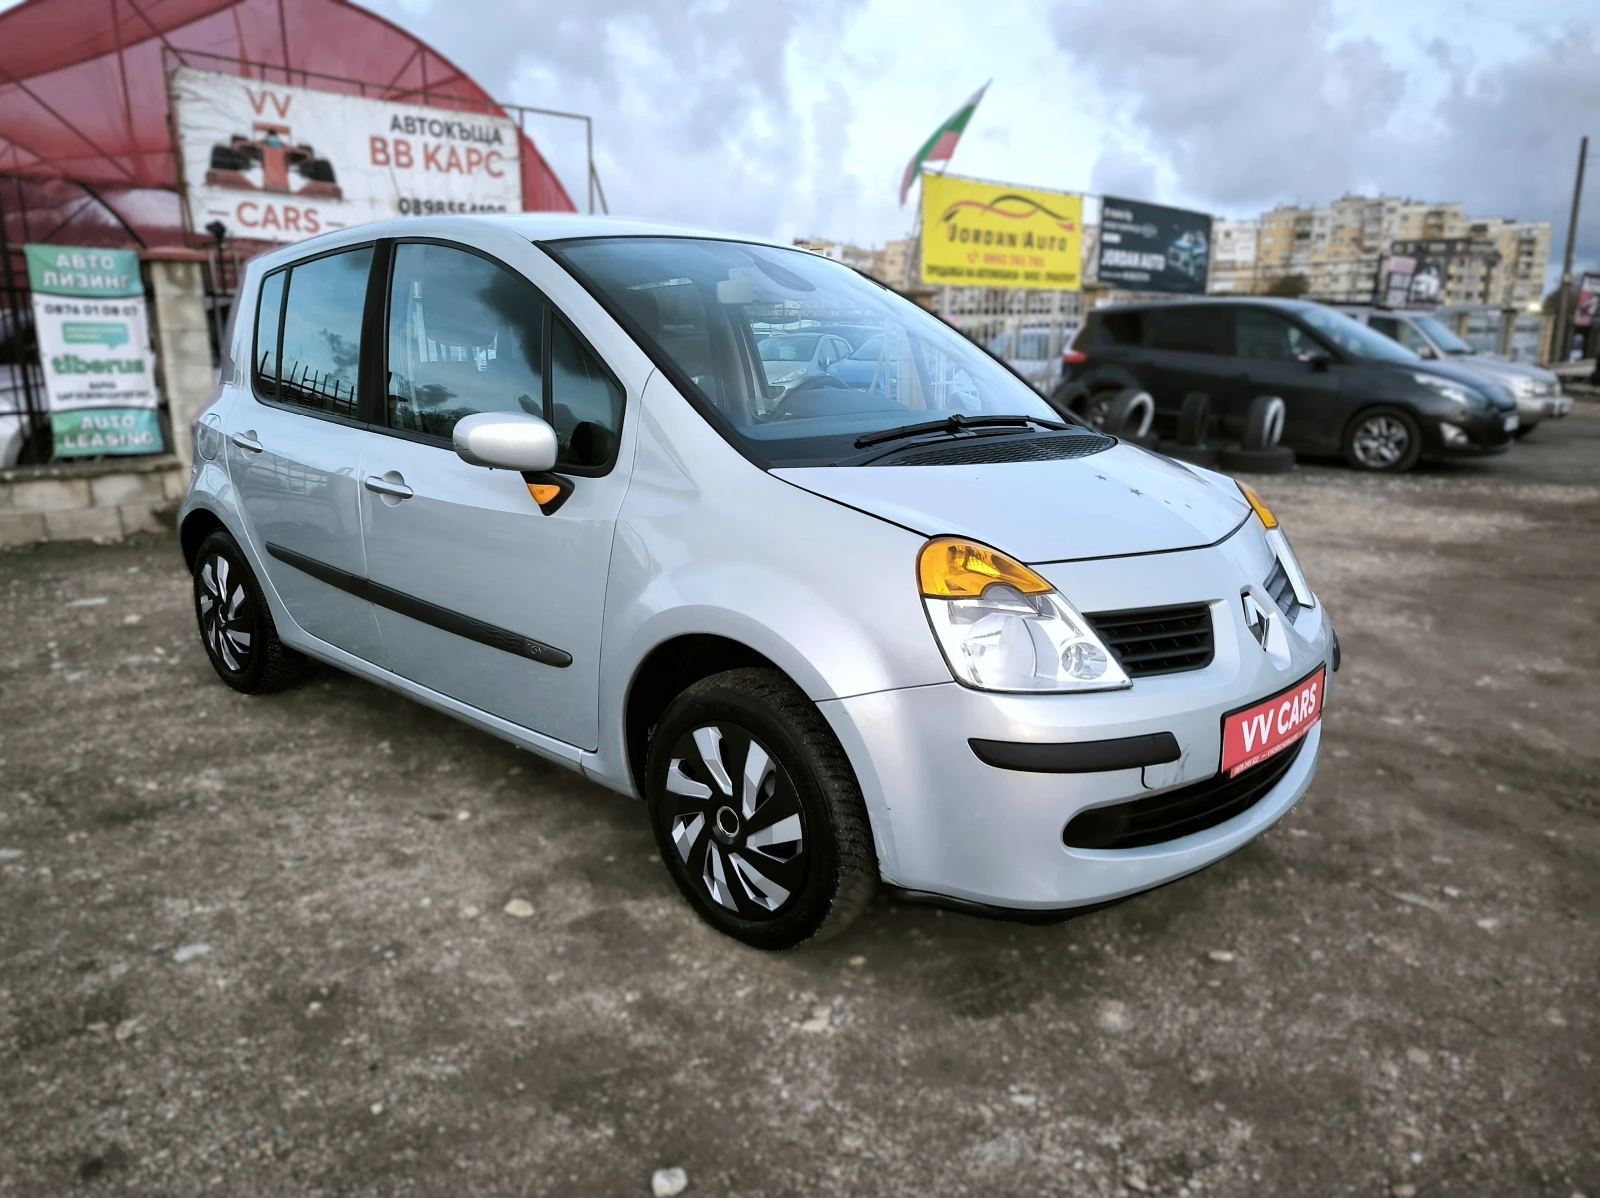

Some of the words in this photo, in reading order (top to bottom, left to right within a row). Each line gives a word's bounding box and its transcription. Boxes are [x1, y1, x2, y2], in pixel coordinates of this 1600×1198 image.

[246, 88, 292, 119] VV
[390, 114, 504, 146] АВТОКЪЩА
[369, 136, 414, 169] ВВ
[423, 146, 505, 179] КАРС
[236, 201, 321, 235] CARS
[56, 253, 115, 271] АВТО
[43, 271, 129, 289] ЛИЗИНГ
[80, 415, 135, 431] AUTO
[63, 430, 154, 449] LEASING
[1241, 708, 1275, 753] VV
[1277, 682, 1317, 735] CARS
